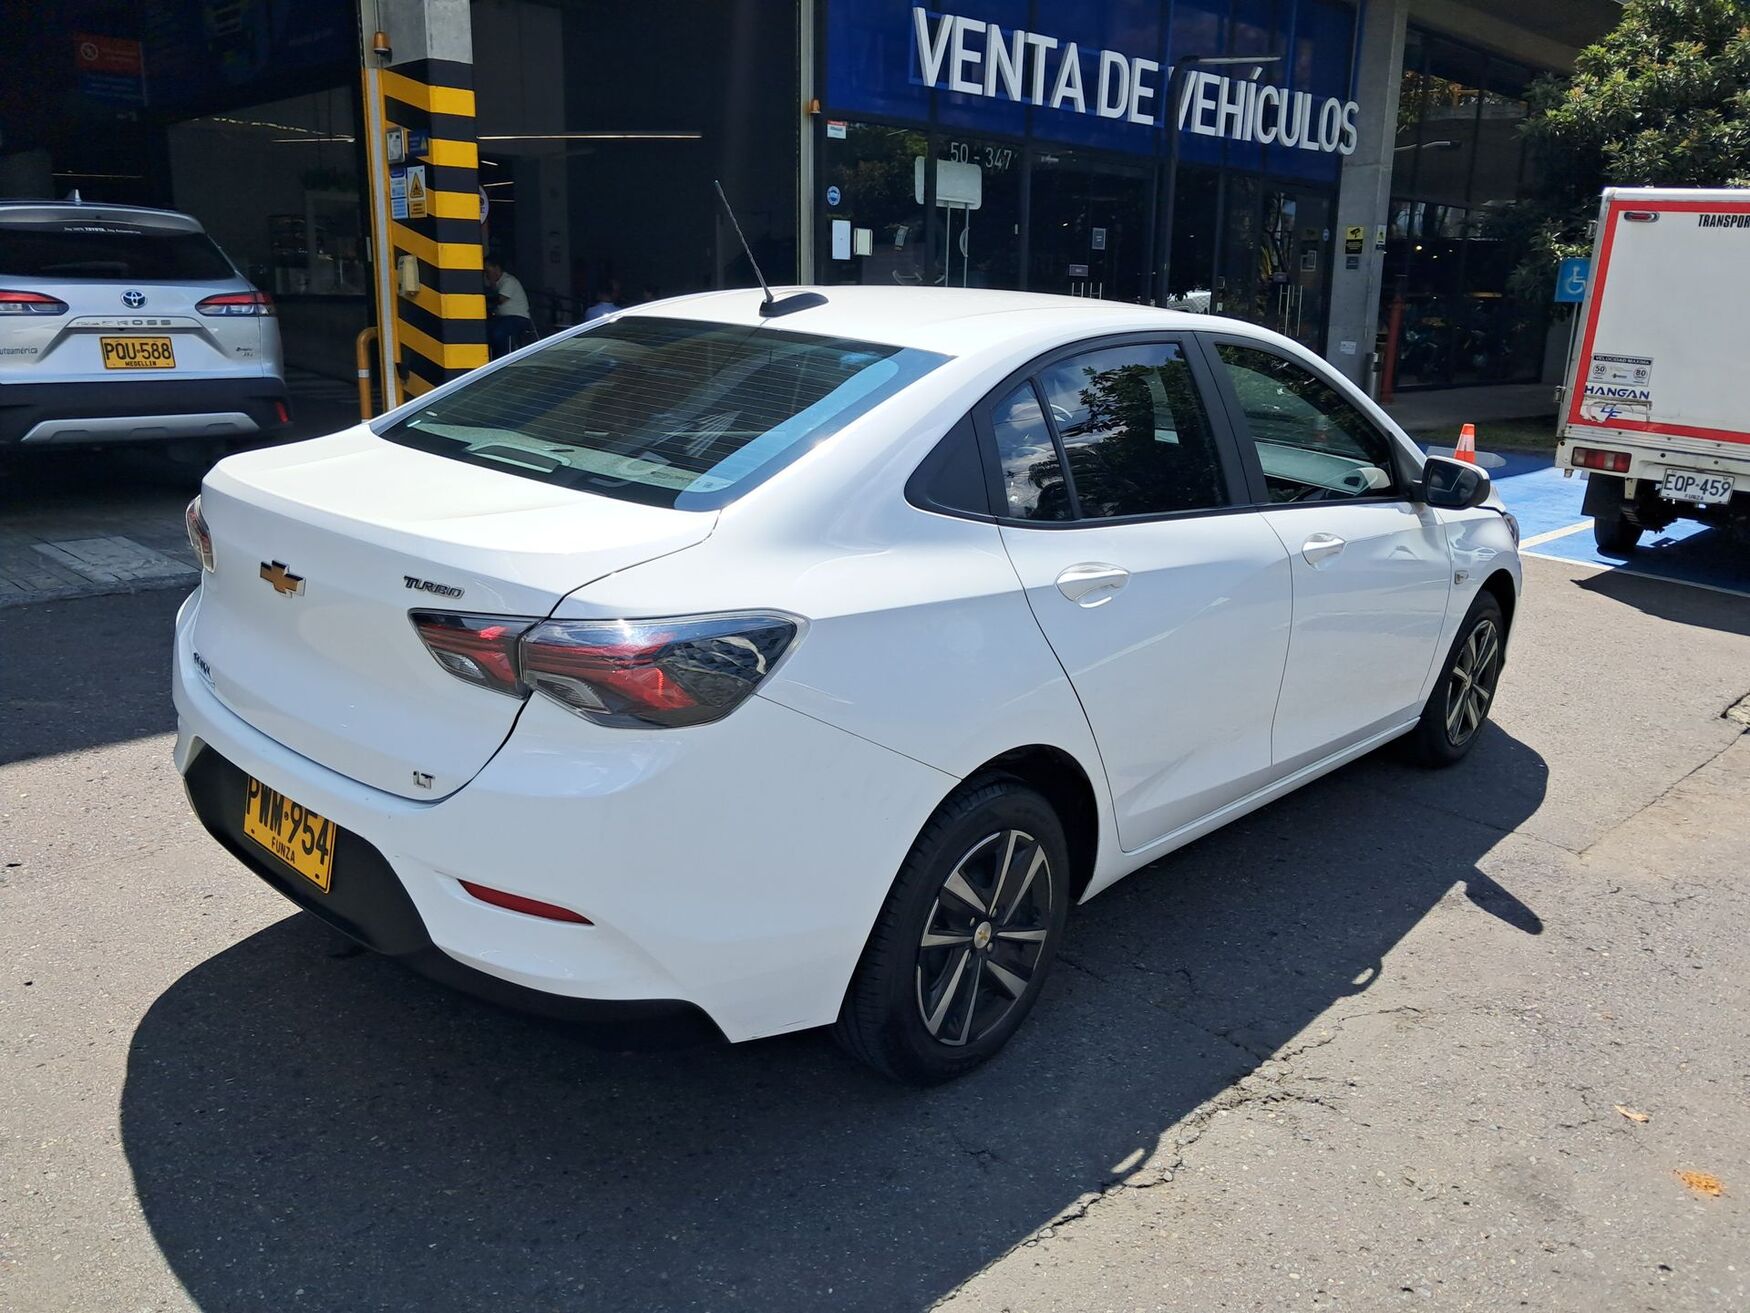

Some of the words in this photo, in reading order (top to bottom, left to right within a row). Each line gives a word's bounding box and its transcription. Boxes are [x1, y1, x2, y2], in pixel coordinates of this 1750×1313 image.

[913, 7, 1086, 113] VENTA
[1096, 50, 1159, 125] DE
[1168, 66, 1359, 155] VEHÍCULOS
[950, 142, 968, 163] 50
[985, 147, 1012, 169] 347
[1698, 214, 1750, 228] TRANSPOR
[1635, 369, 1647, 377] 80
[403, 575, 466, 600] TURBO
[413, 770, 435, 790] LT
[271, 836, 296, 865] FUNZA
